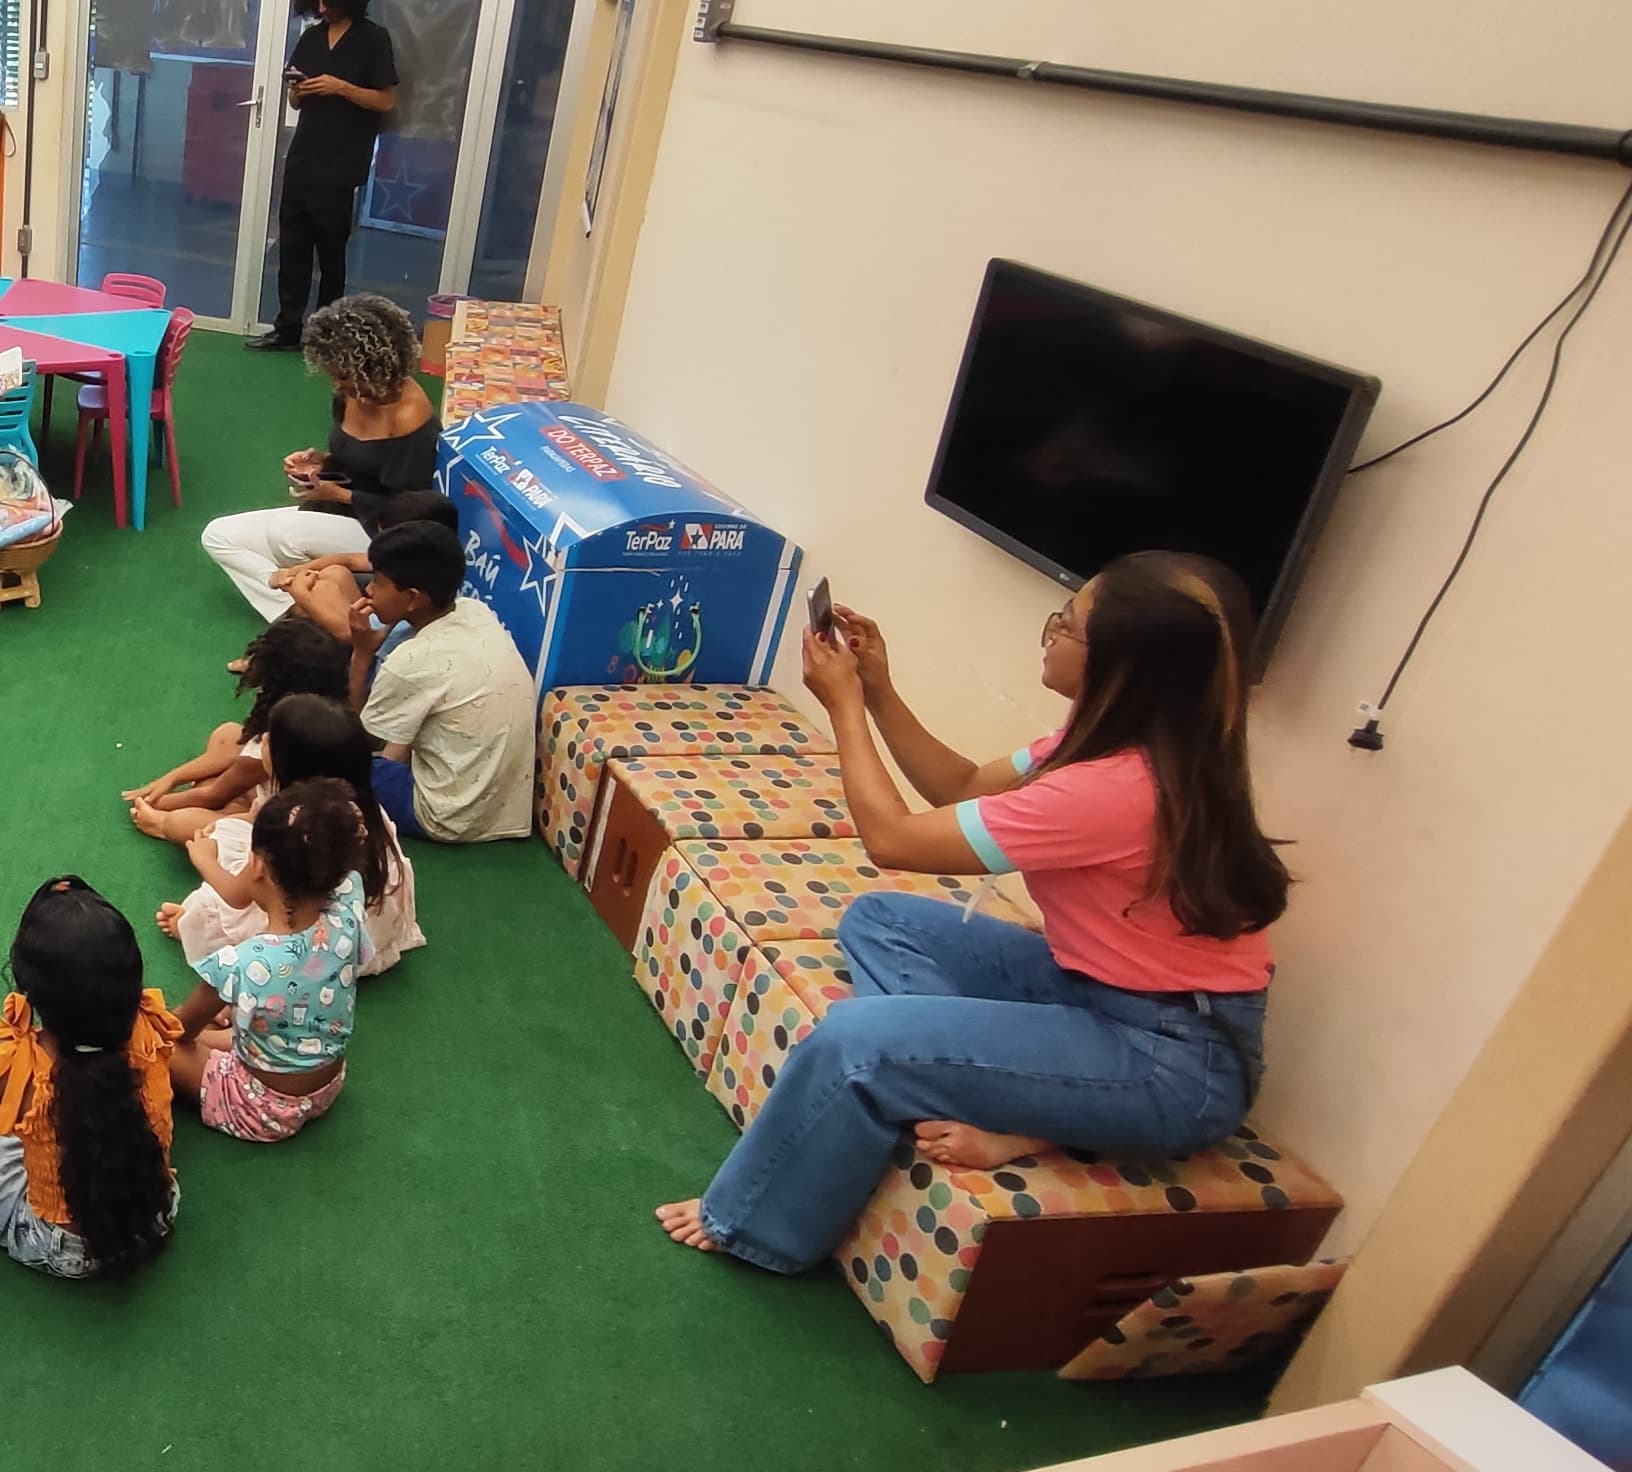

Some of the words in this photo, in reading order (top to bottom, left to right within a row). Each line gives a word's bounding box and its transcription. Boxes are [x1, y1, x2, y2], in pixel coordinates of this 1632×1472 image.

[548, 430, 576, 444] DO
[565, 442, 618, 478] TERPAZ
[625, 531, 673, 551] TerPaz
